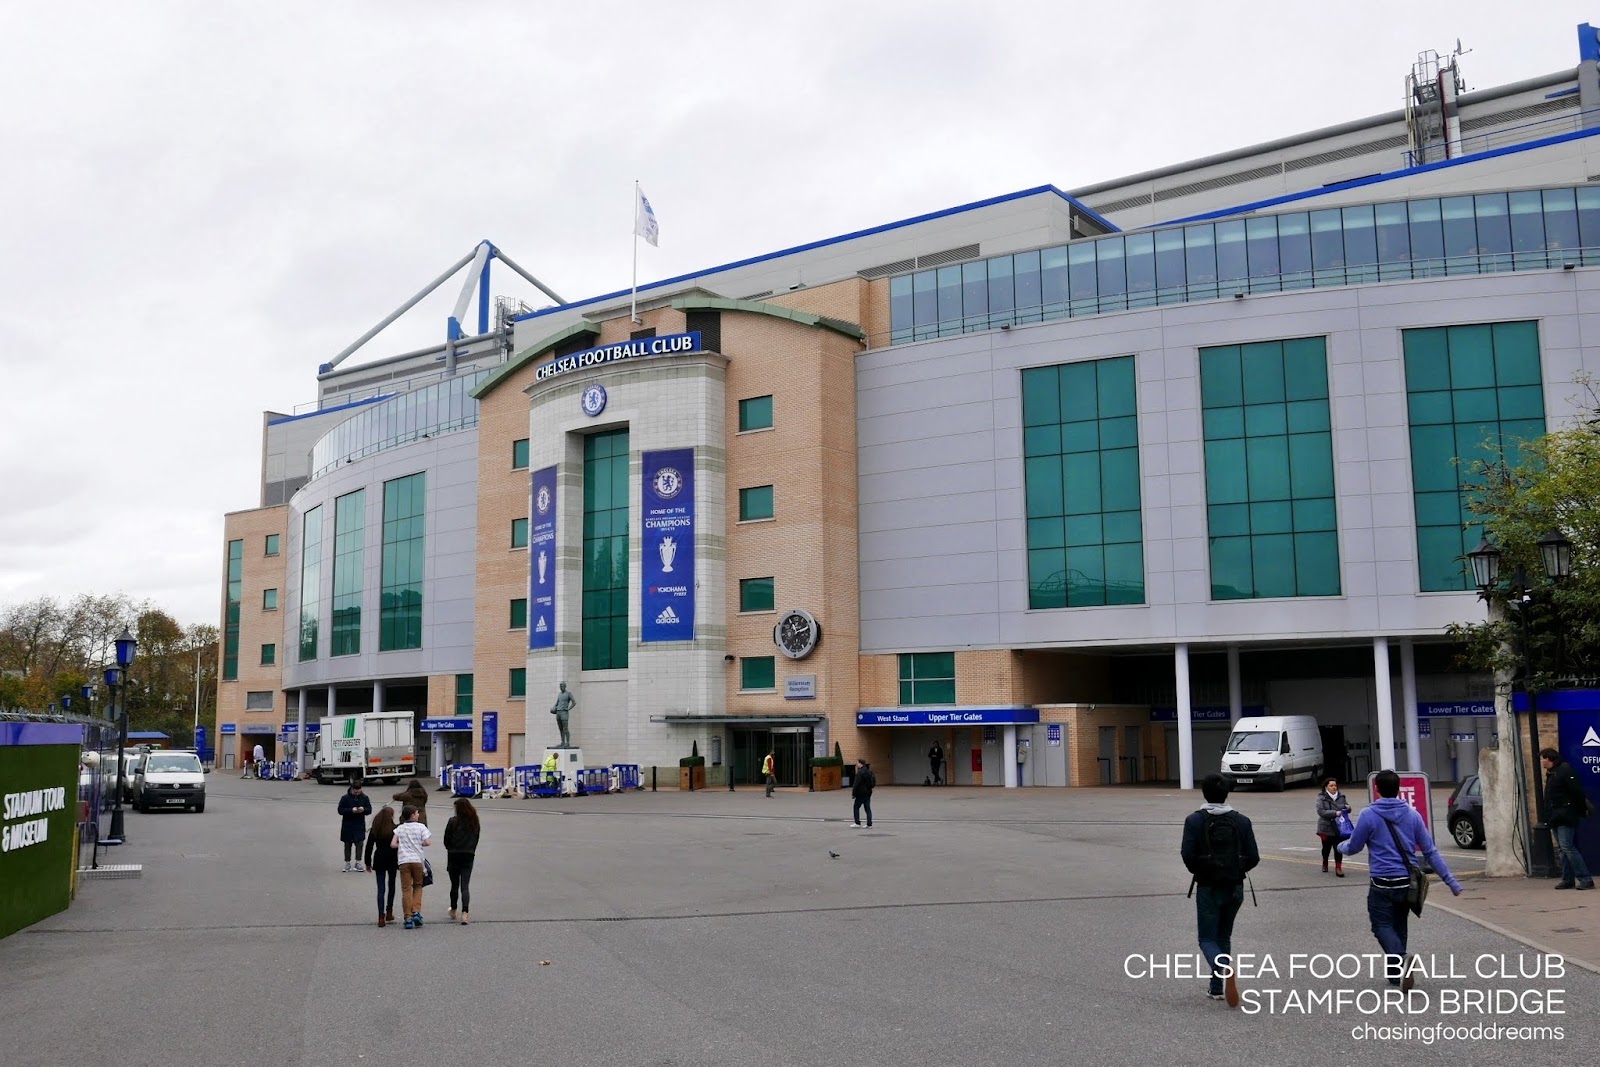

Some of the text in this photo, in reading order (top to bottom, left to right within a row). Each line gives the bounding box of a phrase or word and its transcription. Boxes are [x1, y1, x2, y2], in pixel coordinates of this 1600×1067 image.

[536, 336, 692, 380] CHELSEA FOOTBALL CLUB
[646, 519, 690, 528] CHAMPIONS
[928, 714, 949, 723] Upper
[964, 713, 983, 721] Gates
[4, 786, 66, 820] STADIUM TOUR
[2, 818, 48, 852] & MUSEUM
